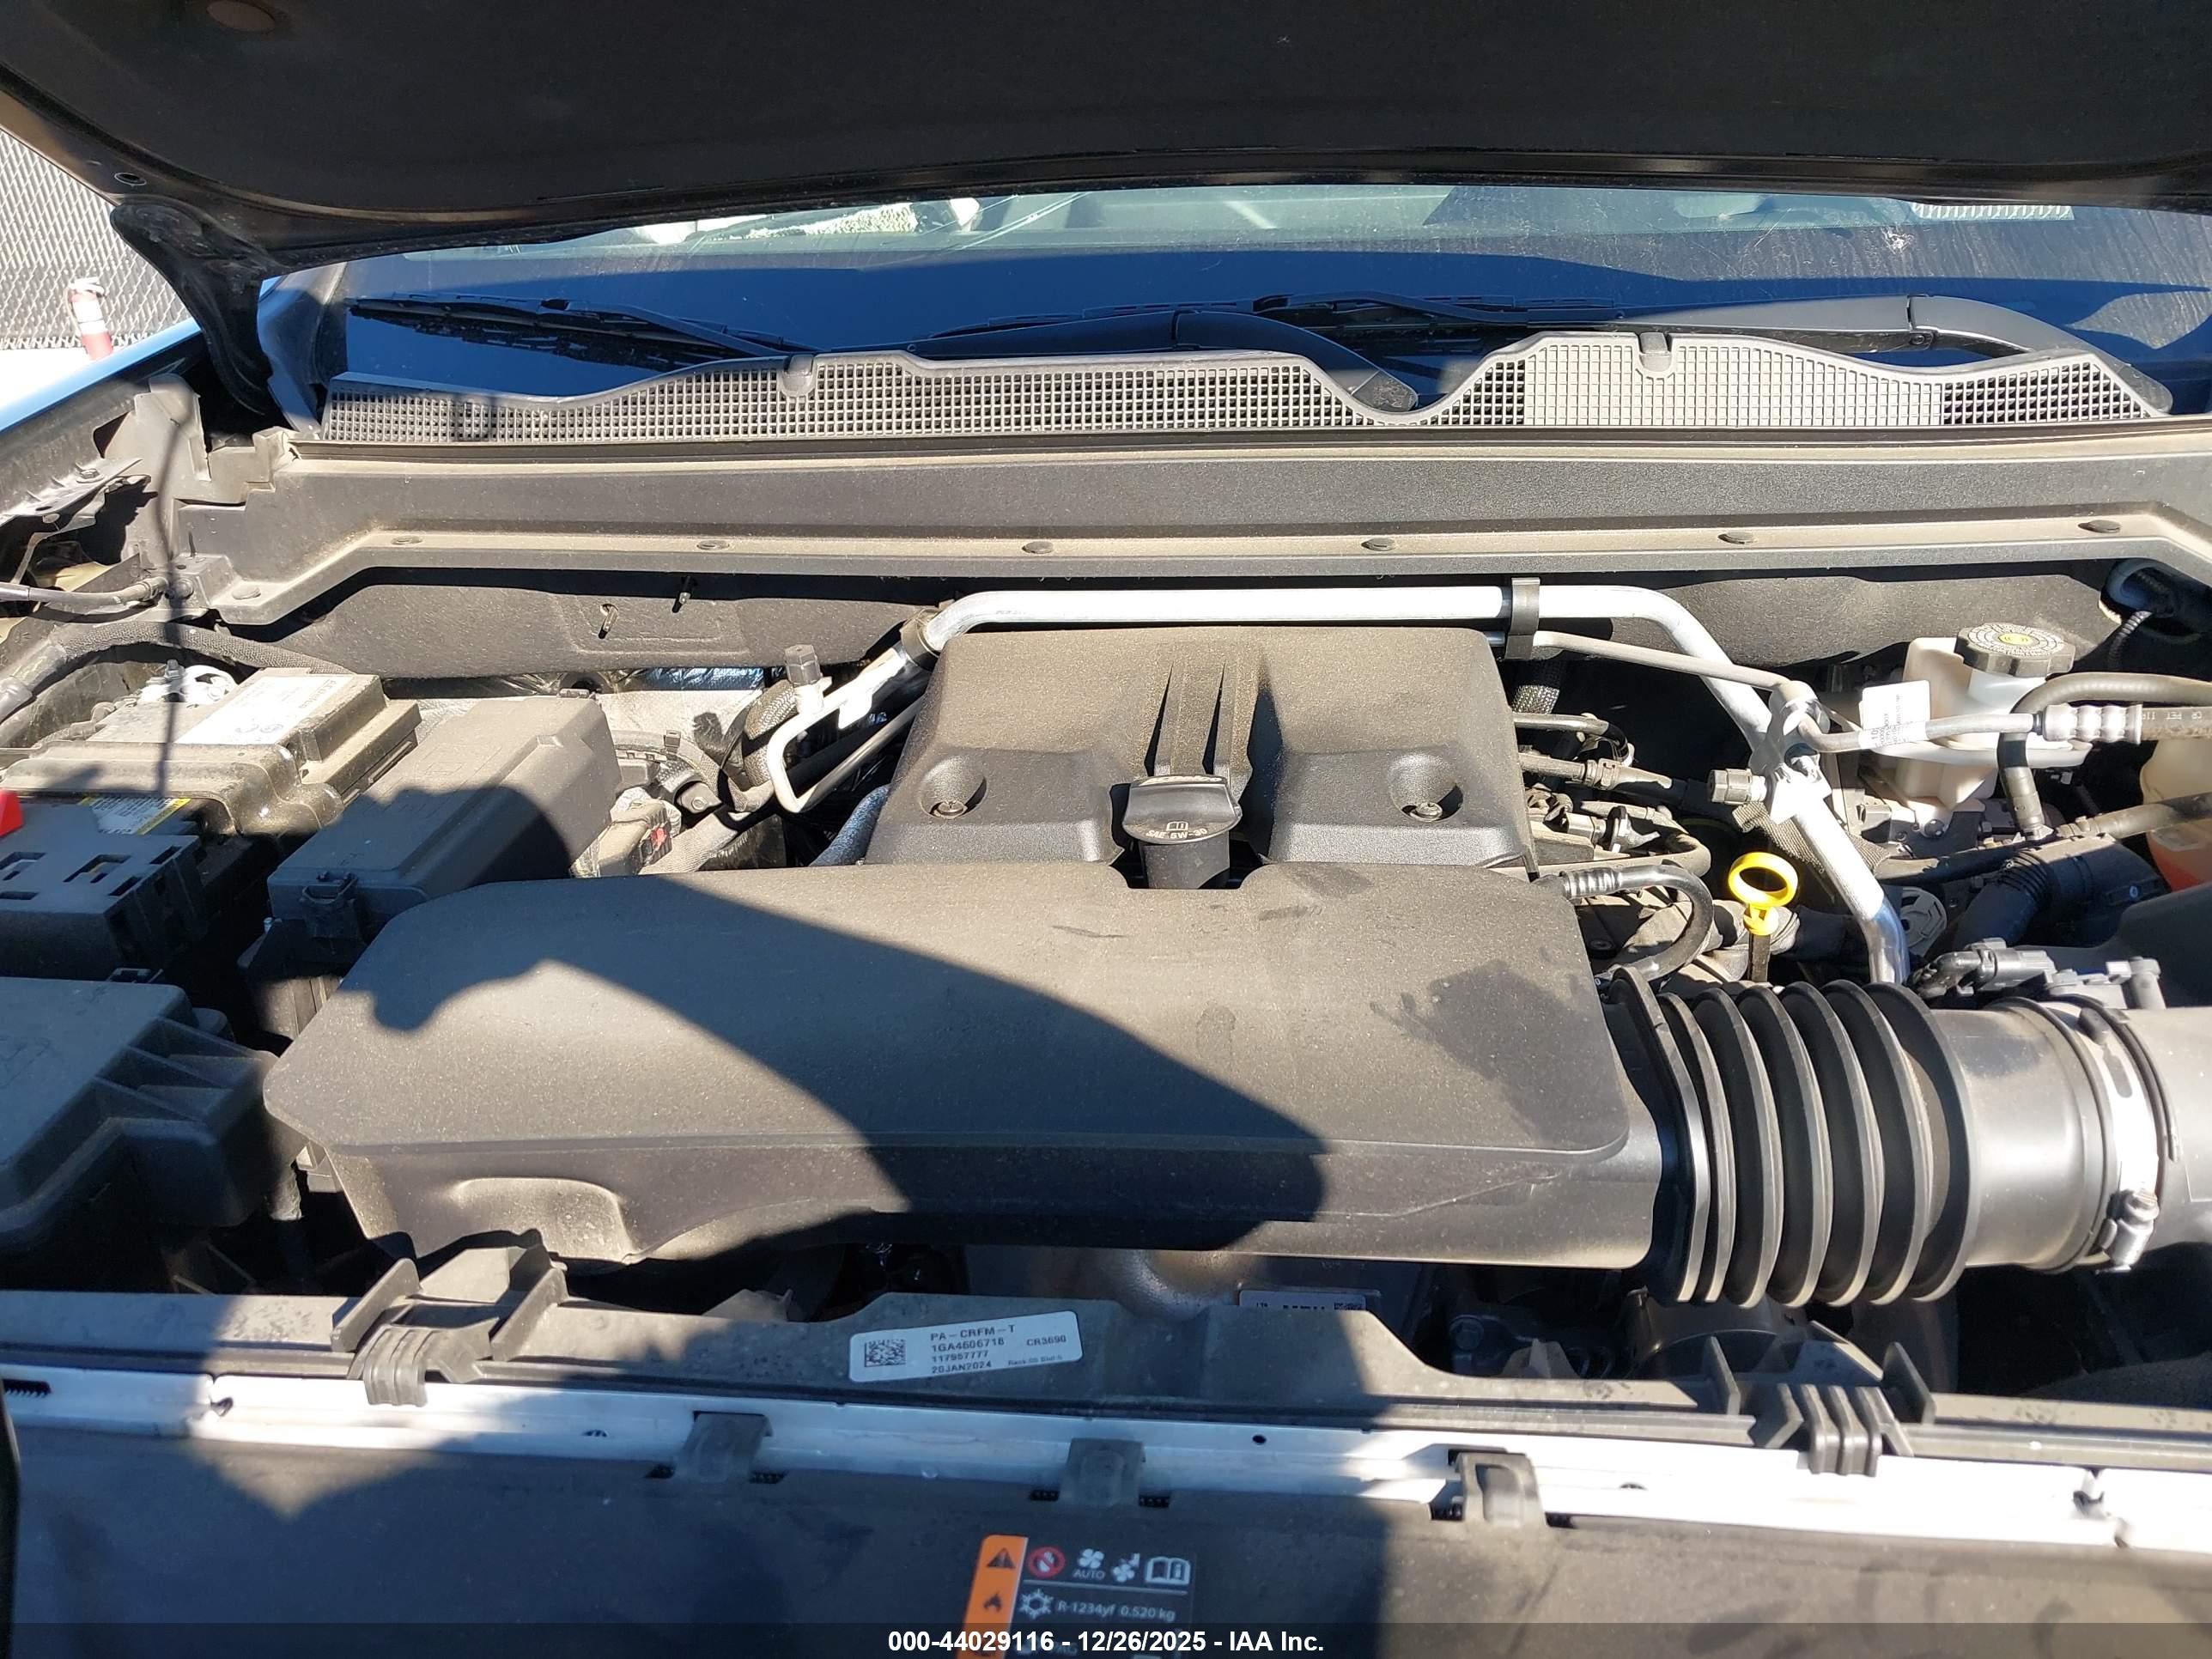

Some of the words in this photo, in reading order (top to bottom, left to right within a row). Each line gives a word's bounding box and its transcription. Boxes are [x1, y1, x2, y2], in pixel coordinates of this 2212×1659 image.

[1146, 829, 1167, 839] SAE
[1170, 827, 1208, 839] 5W-30
[1073, 1570, 1106, 1581] AUTO
[1057, 1602, 1115, 1619] R-1234yf
[1121, 1605, 1156, 1619] 0.520
[1158, 1606, 1176, 1623] kg
